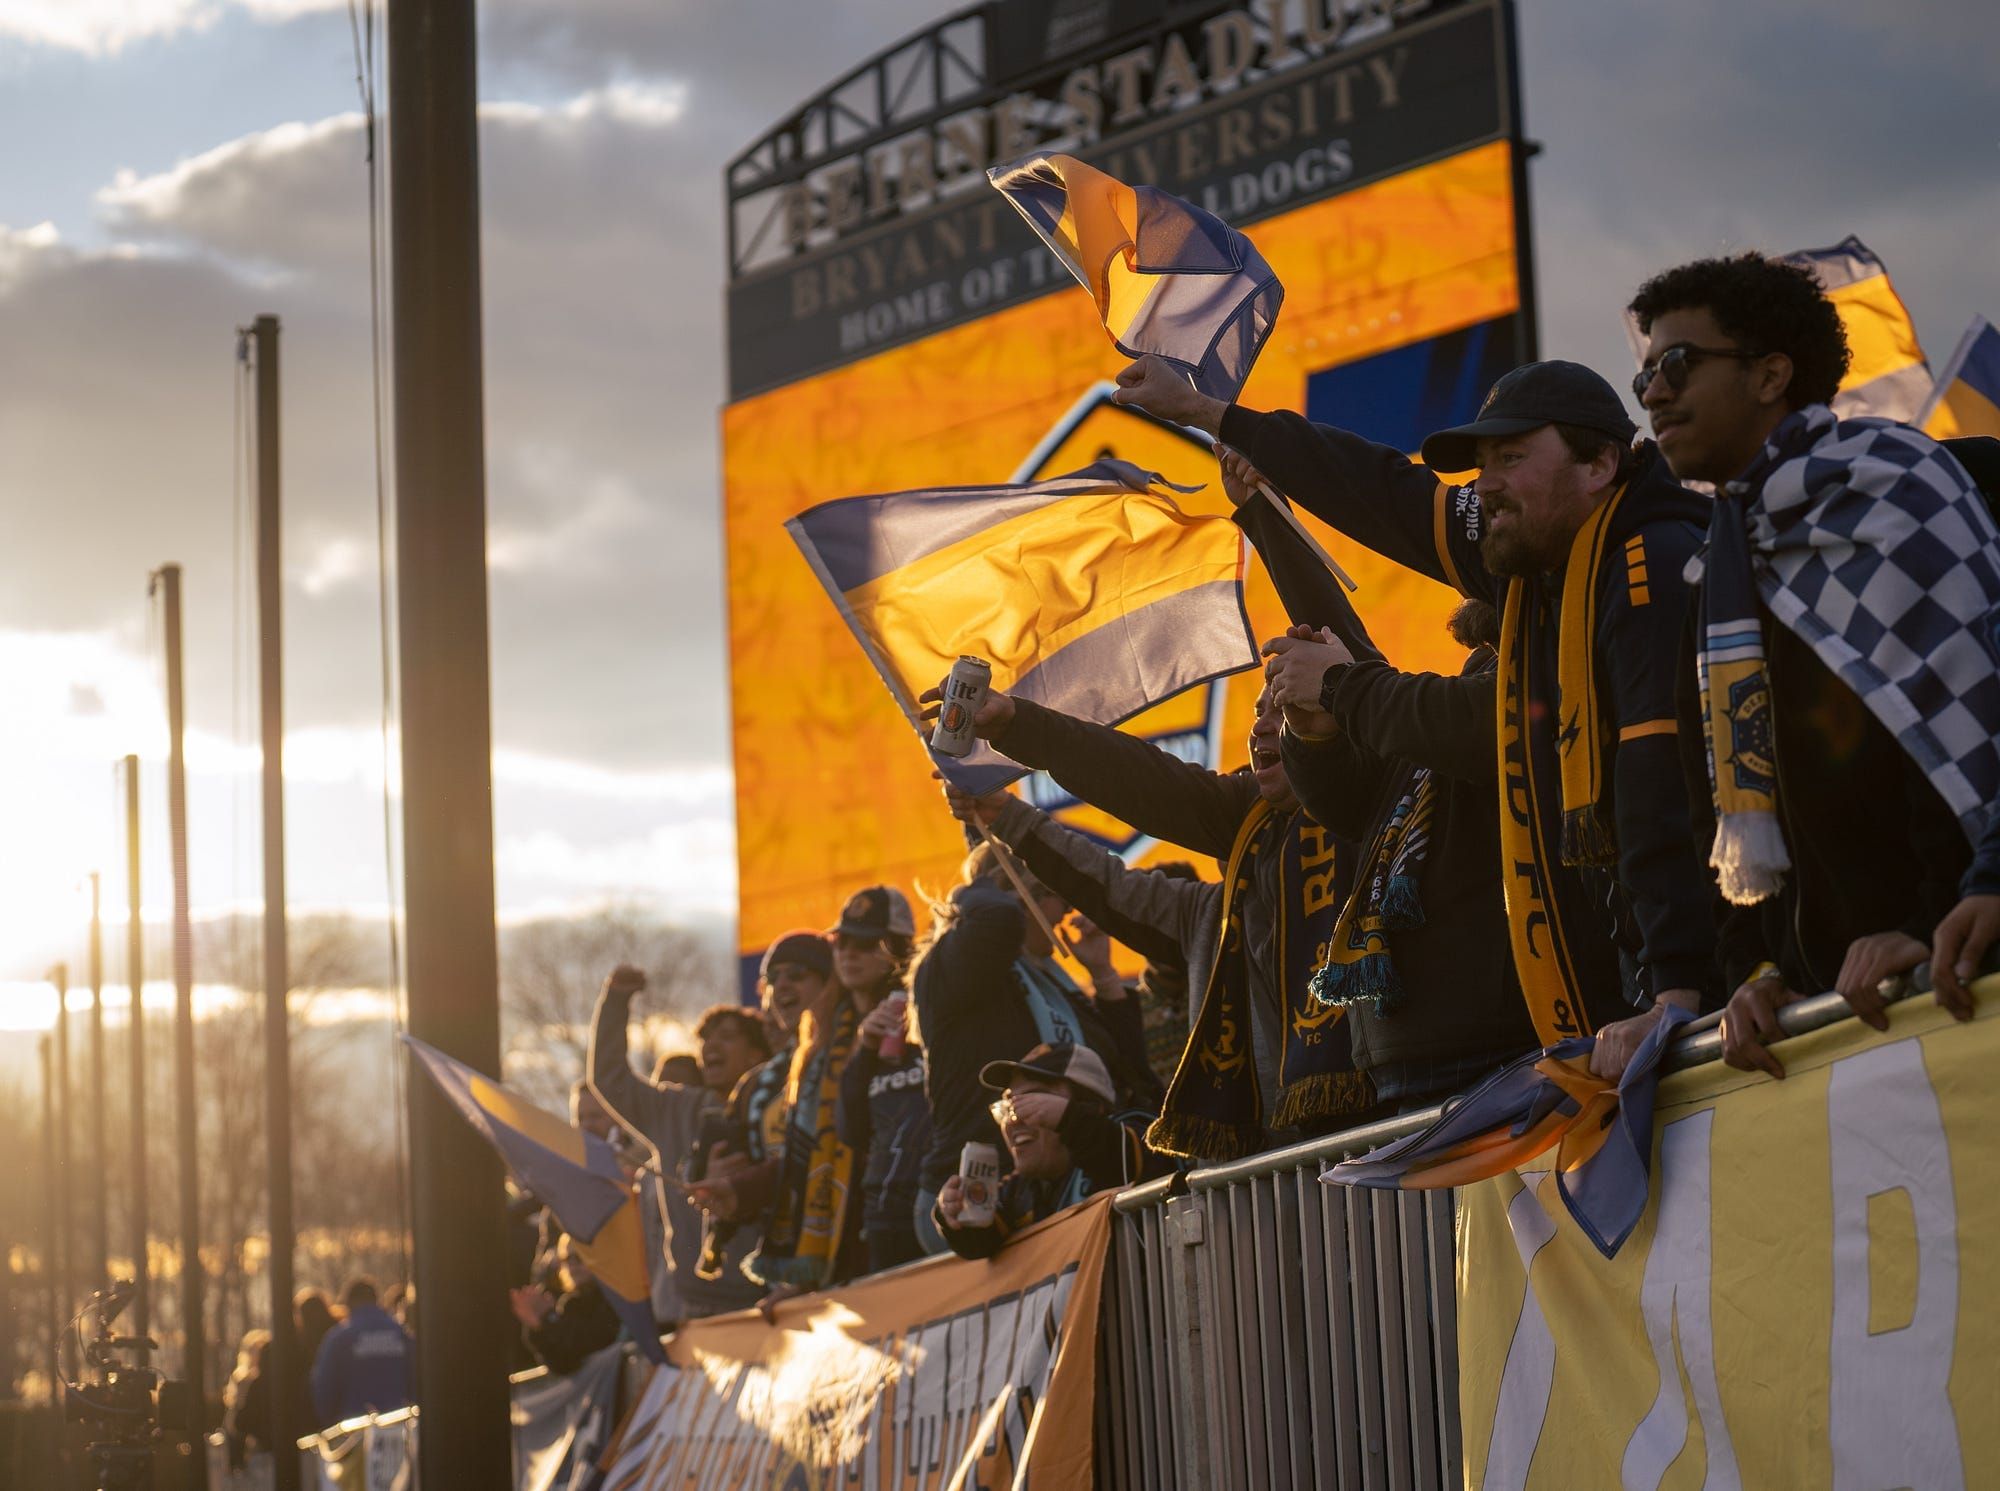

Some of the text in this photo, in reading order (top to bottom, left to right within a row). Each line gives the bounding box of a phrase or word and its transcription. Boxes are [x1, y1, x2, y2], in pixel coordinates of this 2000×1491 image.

[790, 48, 1410, 320] BRYANT IVERSITY
[840, 281, 952, 350] HOME
[961, 257, 1017, 308] OF
[1199, 138, 1354, 216] LDOGS
[1300, 825, 1336, 918] RH
[1306, 1032, 1322, 1047] FC
[966, 1159, 997, 1180] Lite
